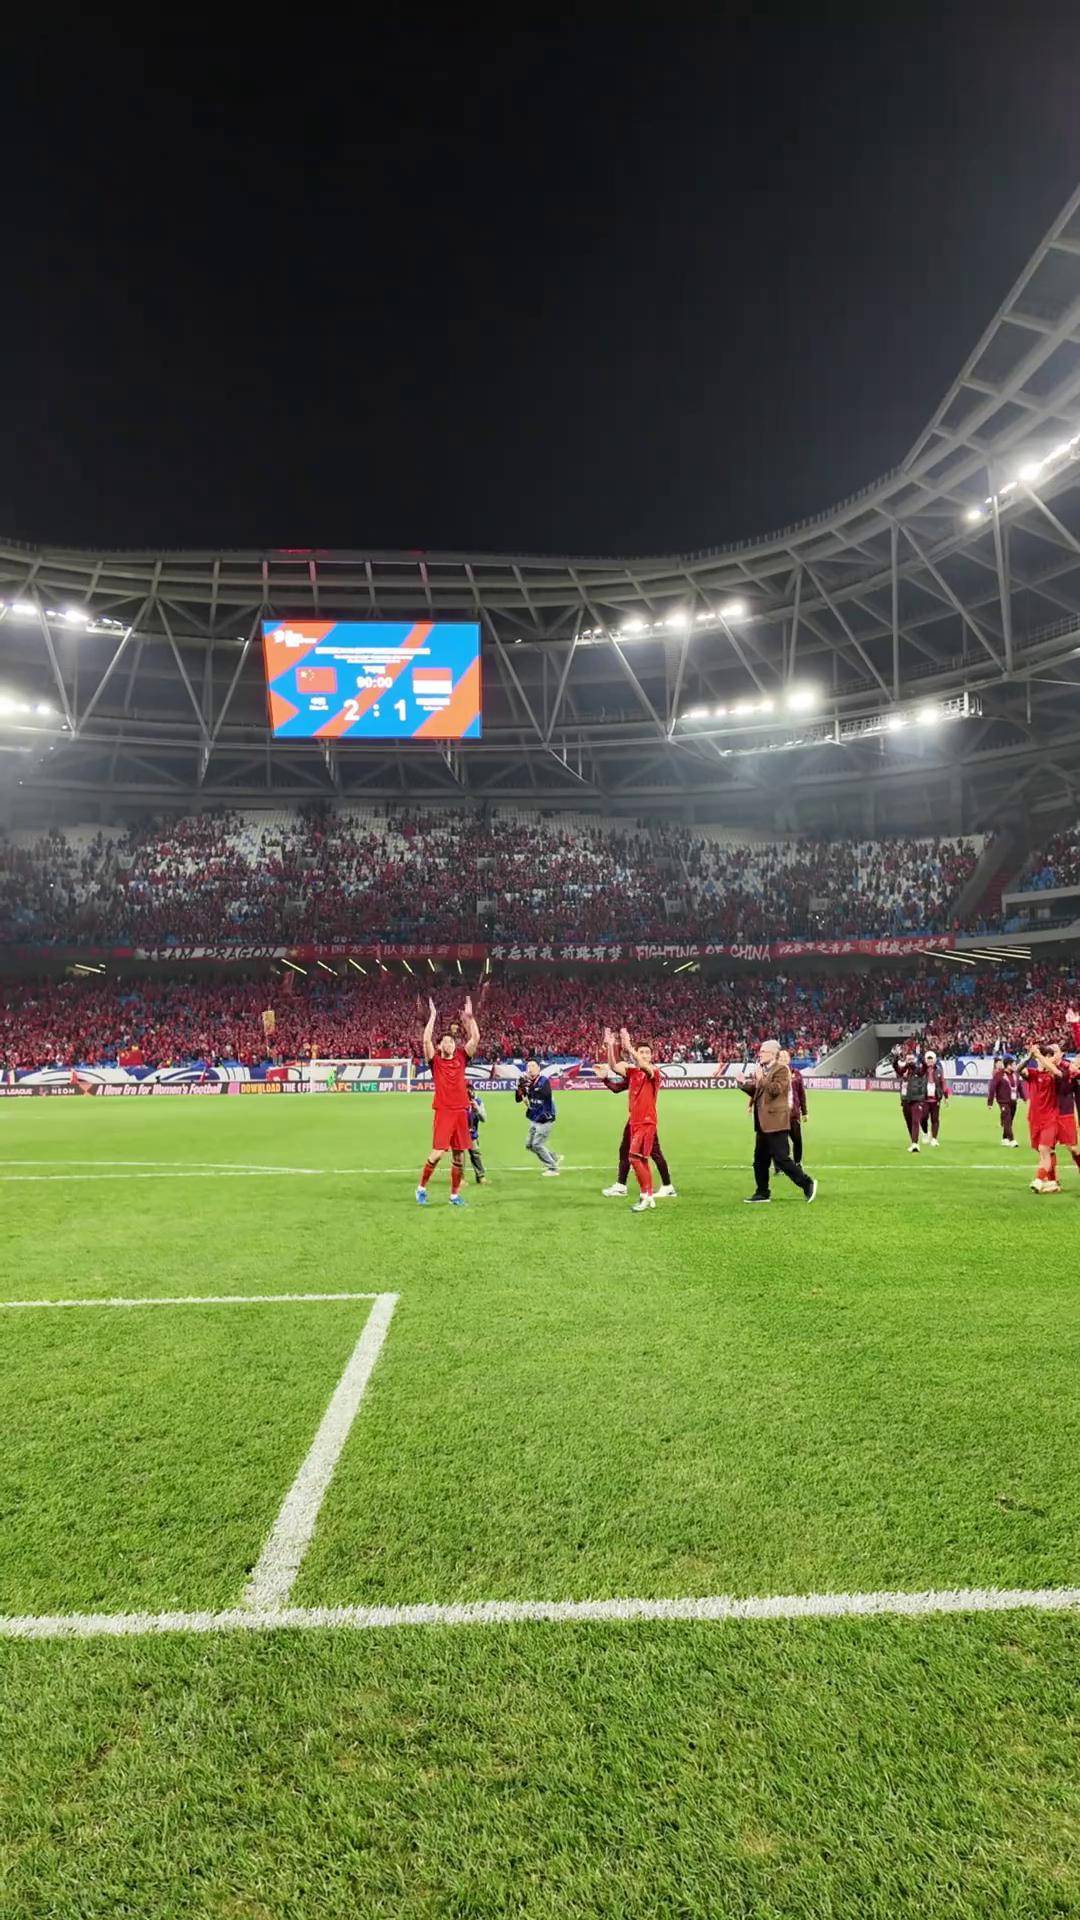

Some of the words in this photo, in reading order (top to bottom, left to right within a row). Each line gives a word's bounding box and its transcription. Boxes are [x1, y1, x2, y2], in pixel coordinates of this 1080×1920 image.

[356, 676, 393, 689] 90:00
[343, 699, 360, 721] 2
[394, 699, 406, 721] 1
[203, 946, 278, 960] DRAGON
[635, 945, 699, 961] FIGHTING
[705, 944, 724, 954] OF
[730, 944, 771, 962] CHINA
[96, 1085, 104, 1095] A
[104, 1084, 122, 1095] New
[122, 1084, 138, 1095] Era
[138, 1084, 152, 1095] for
[152, 1083, 189, 1094] Women's
[189, 1083, 222, 1094] Football
[240, 1083, 281, 1093] DOWNLOAD
[353, 1082, 378, 1092] LIVE
[473, 1080, 509, 1090] CREDIT
[660, 1079, 698, 1088] AIRWAYS
[700, 1079, 738, 1088] NEOM
